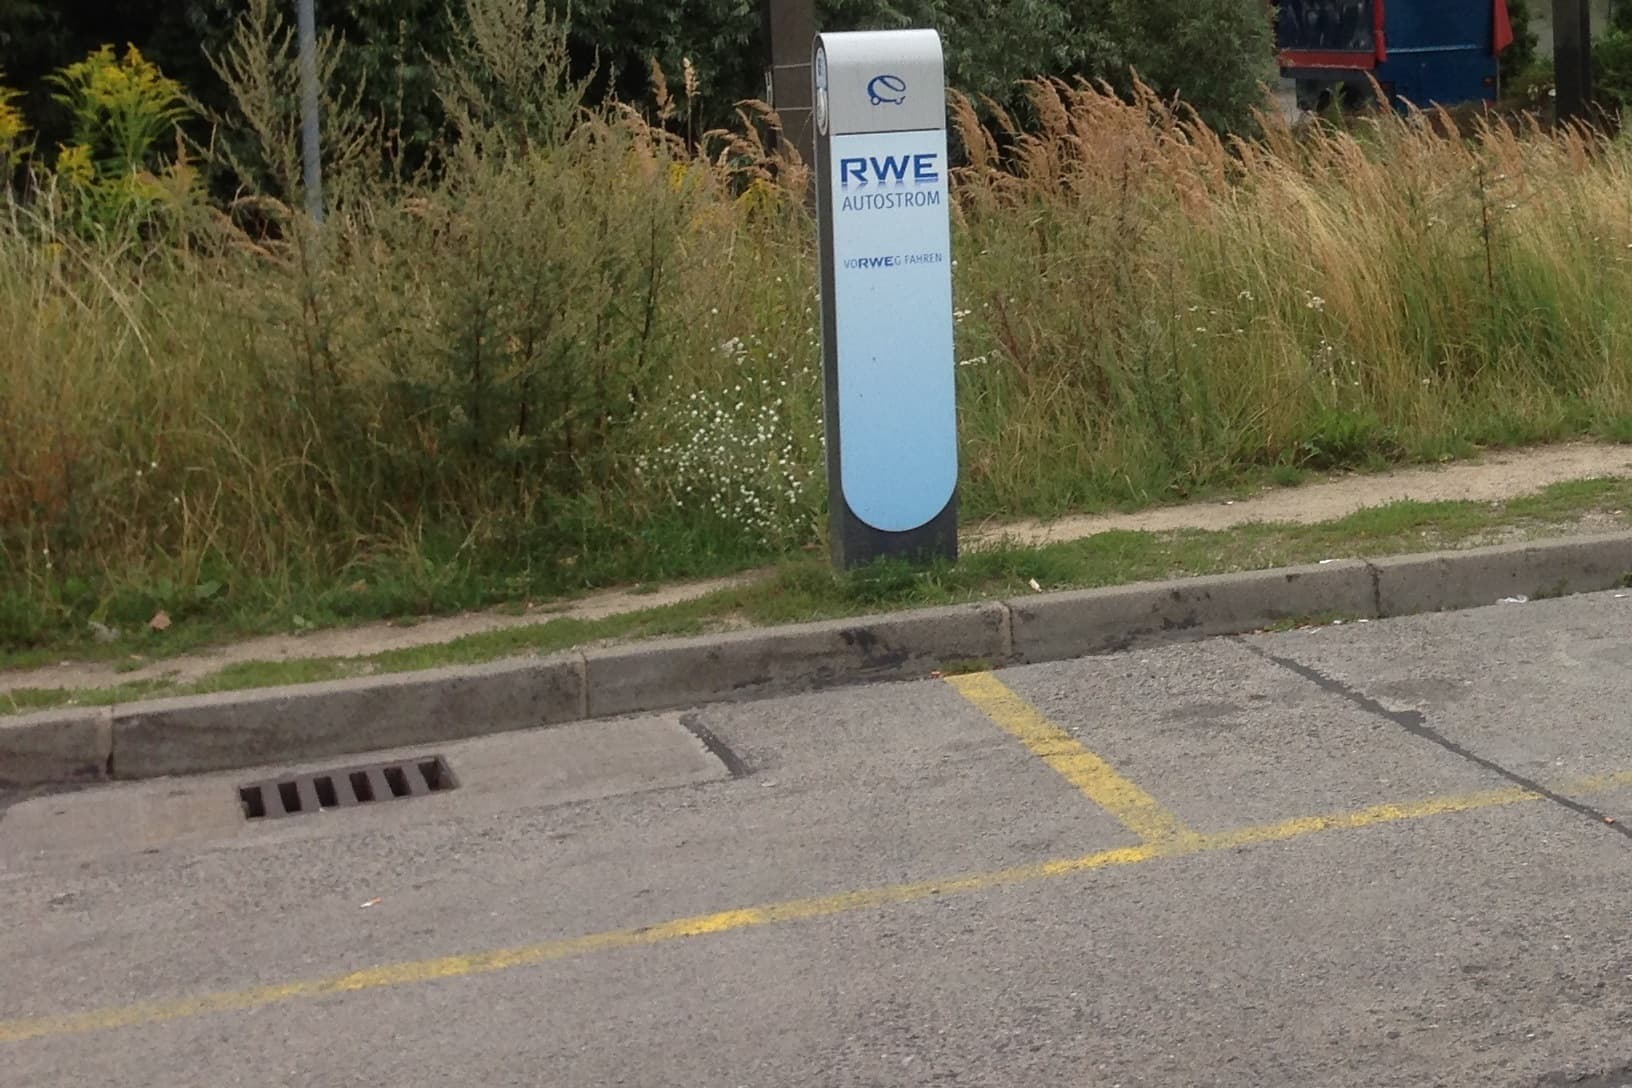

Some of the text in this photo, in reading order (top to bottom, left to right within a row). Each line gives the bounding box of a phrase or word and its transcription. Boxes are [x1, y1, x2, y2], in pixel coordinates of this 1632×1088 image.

[841, 154, 938, 183] RWE
[842, 190, 940, 211] AUTOSTROM
[844, 252, 942, 269] VORWEG FAHREN
